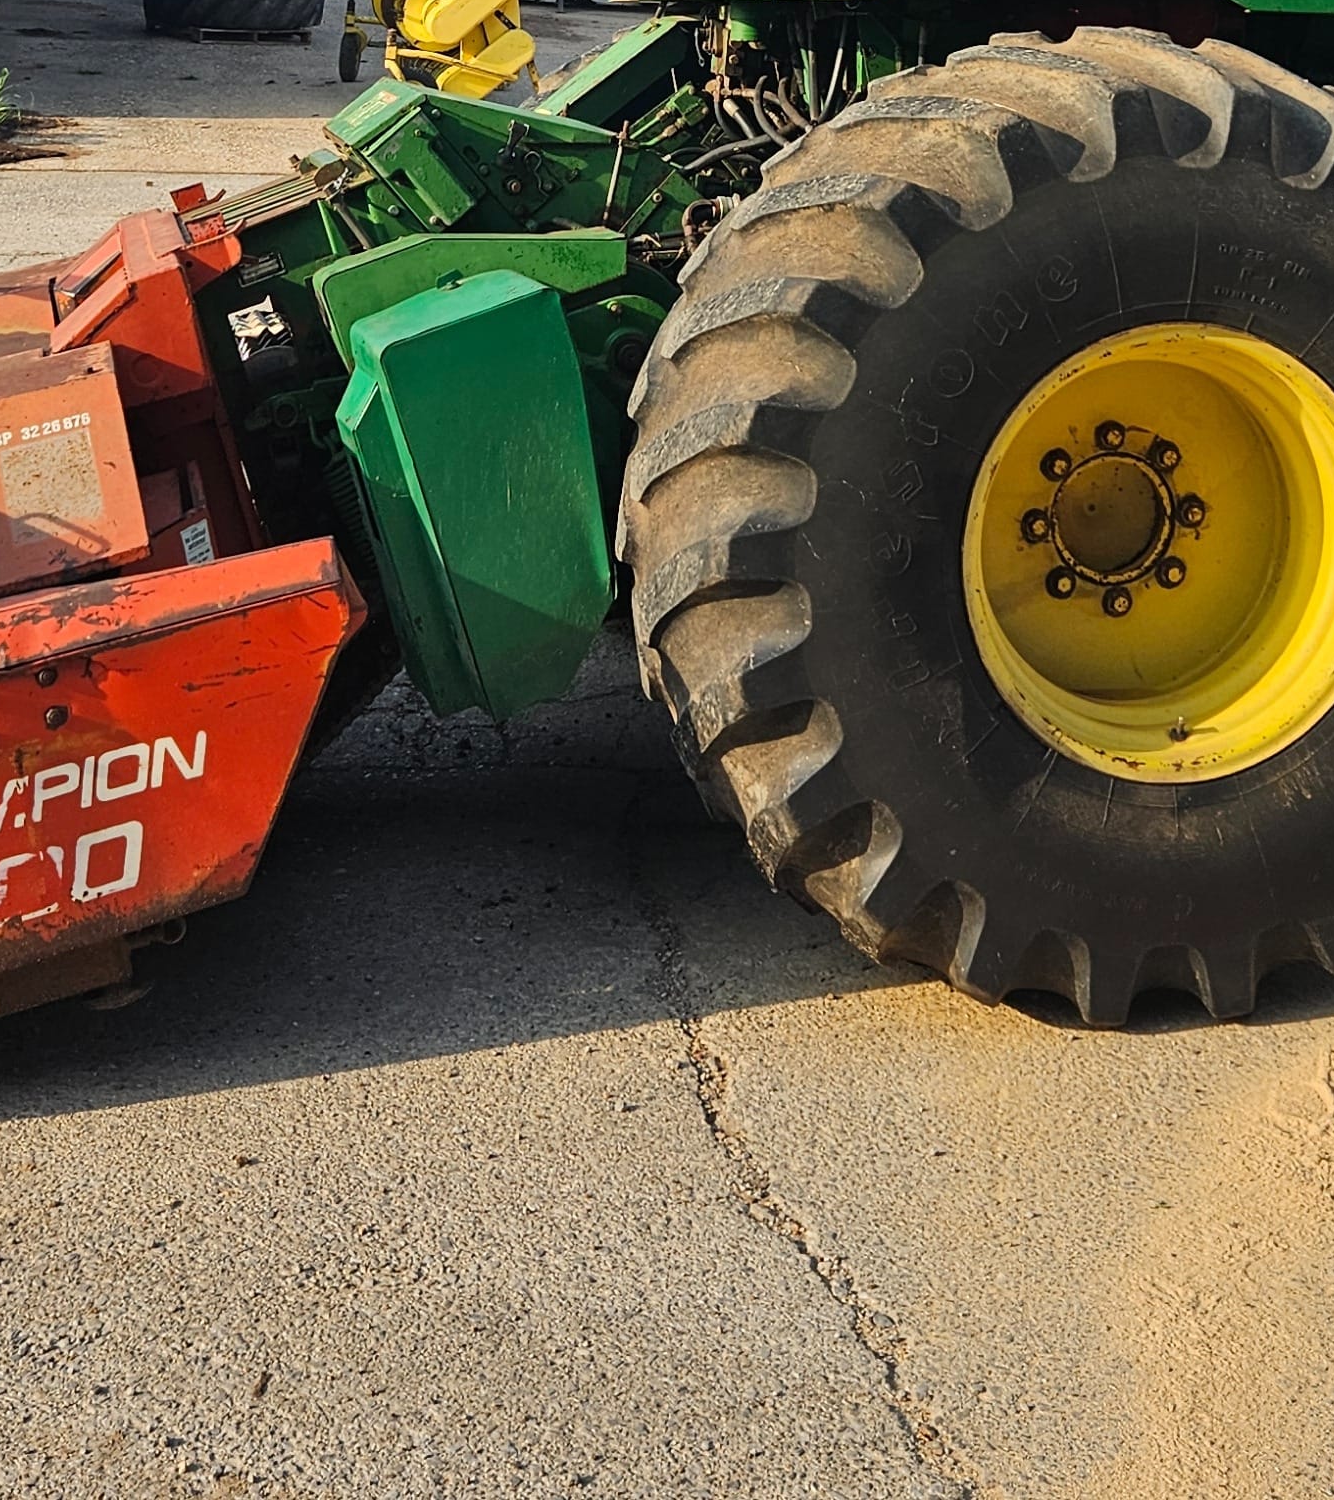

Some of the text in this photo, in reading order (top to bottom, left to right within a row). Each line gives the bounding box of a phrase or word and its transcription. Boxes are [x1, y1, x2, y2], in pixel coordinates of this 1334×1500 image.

[20, 425, 40, 440] 32
[62, 412, 91, 430] 876
[867, 254, 1078, 725] irestone
